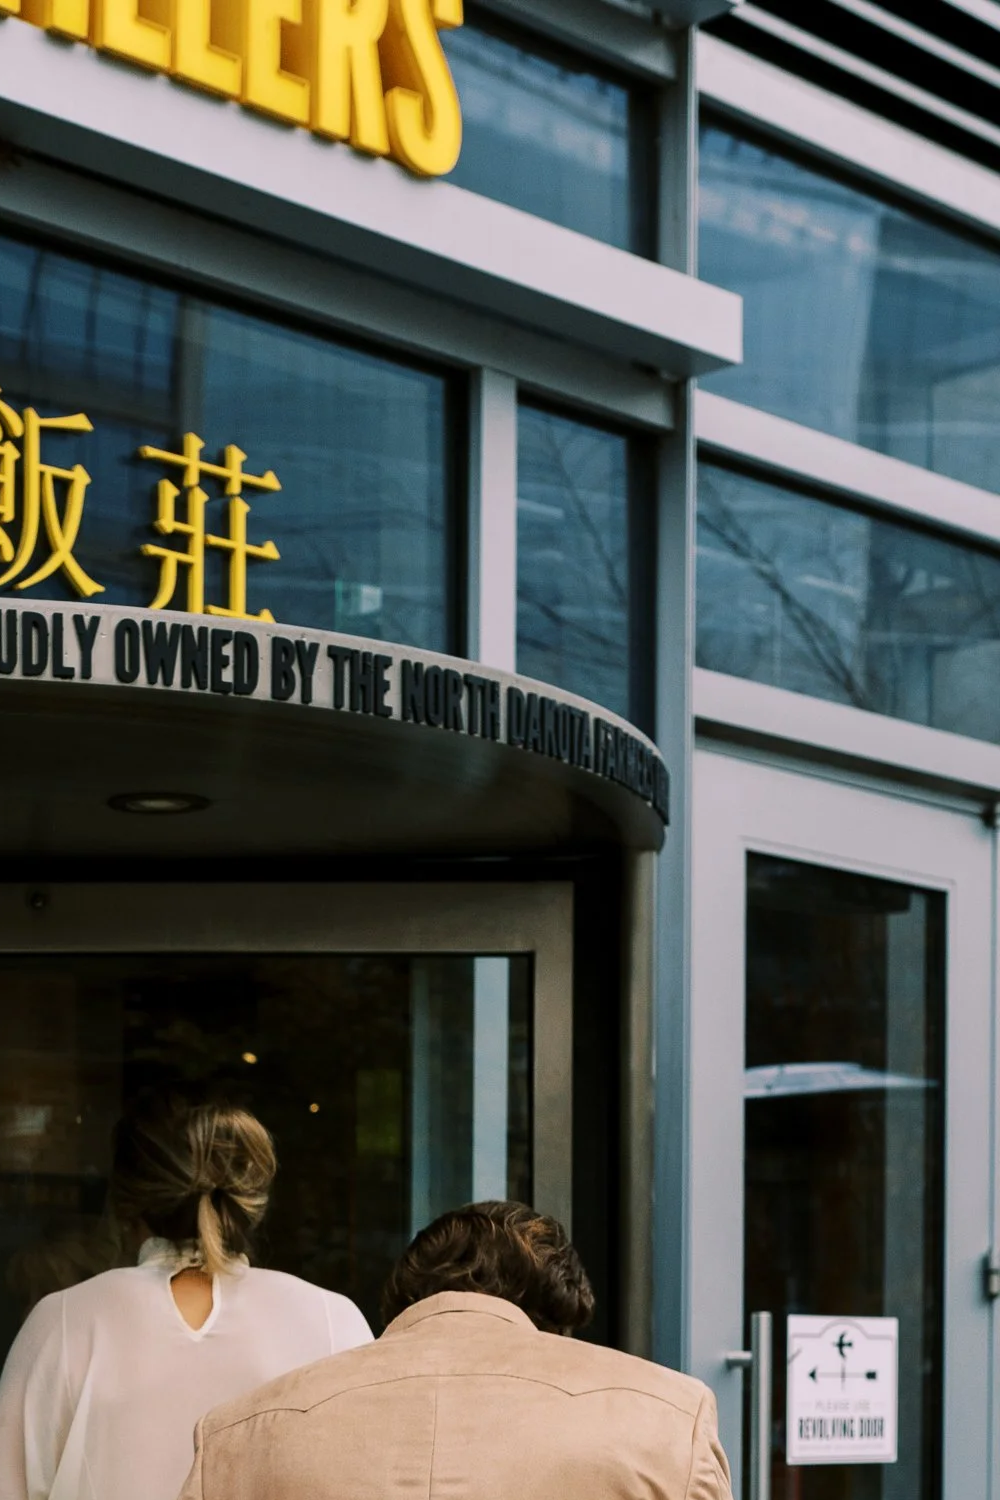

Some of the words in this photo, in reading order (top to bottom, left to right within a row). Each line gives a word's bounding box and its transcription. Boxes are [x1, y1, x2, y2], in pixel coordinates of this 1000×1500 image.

[114, 617, 260, 697] OWNED
[270, 635, 320, 705] BY
[326, 644, 393, 718] THE
[401, 658, 500, 742] NORTH
[507, 686, 592, 768] DAKOTA
[798, 1416, 855, 1439] REVOLVING
[859, 1416, 884, 1438] DOOR
